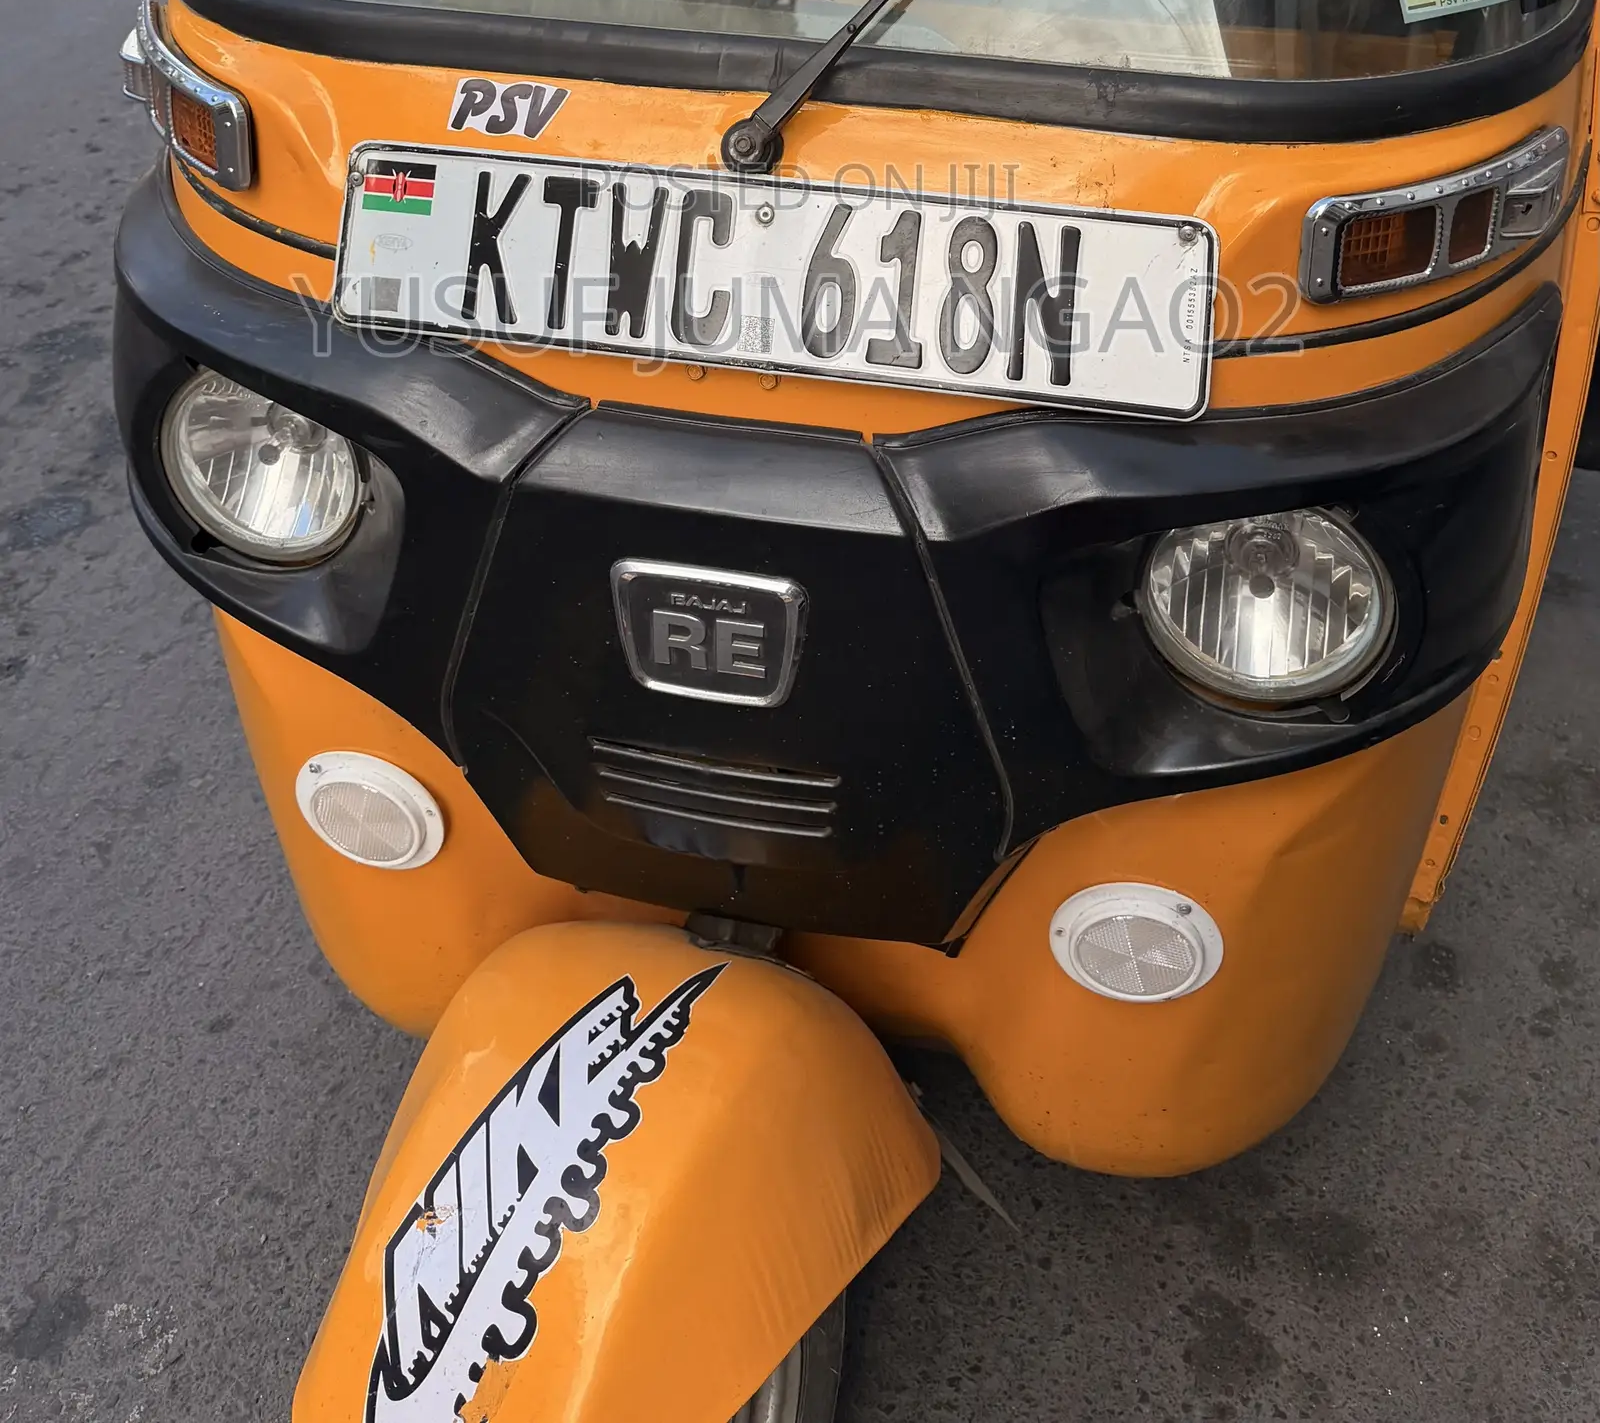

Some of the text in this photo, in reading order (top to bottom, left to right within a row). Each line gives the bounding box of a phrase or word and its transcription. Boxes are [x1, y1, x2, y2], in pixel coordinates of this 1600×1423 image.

[450, 78, 569, 139] PSV
[460, 170, 1082, 386] KTWC 618N
[1183, 338, 1192, 364] NTSA
[670, 593, 746, 614] BAJAJ
[653, 609, 766, 678] RE
